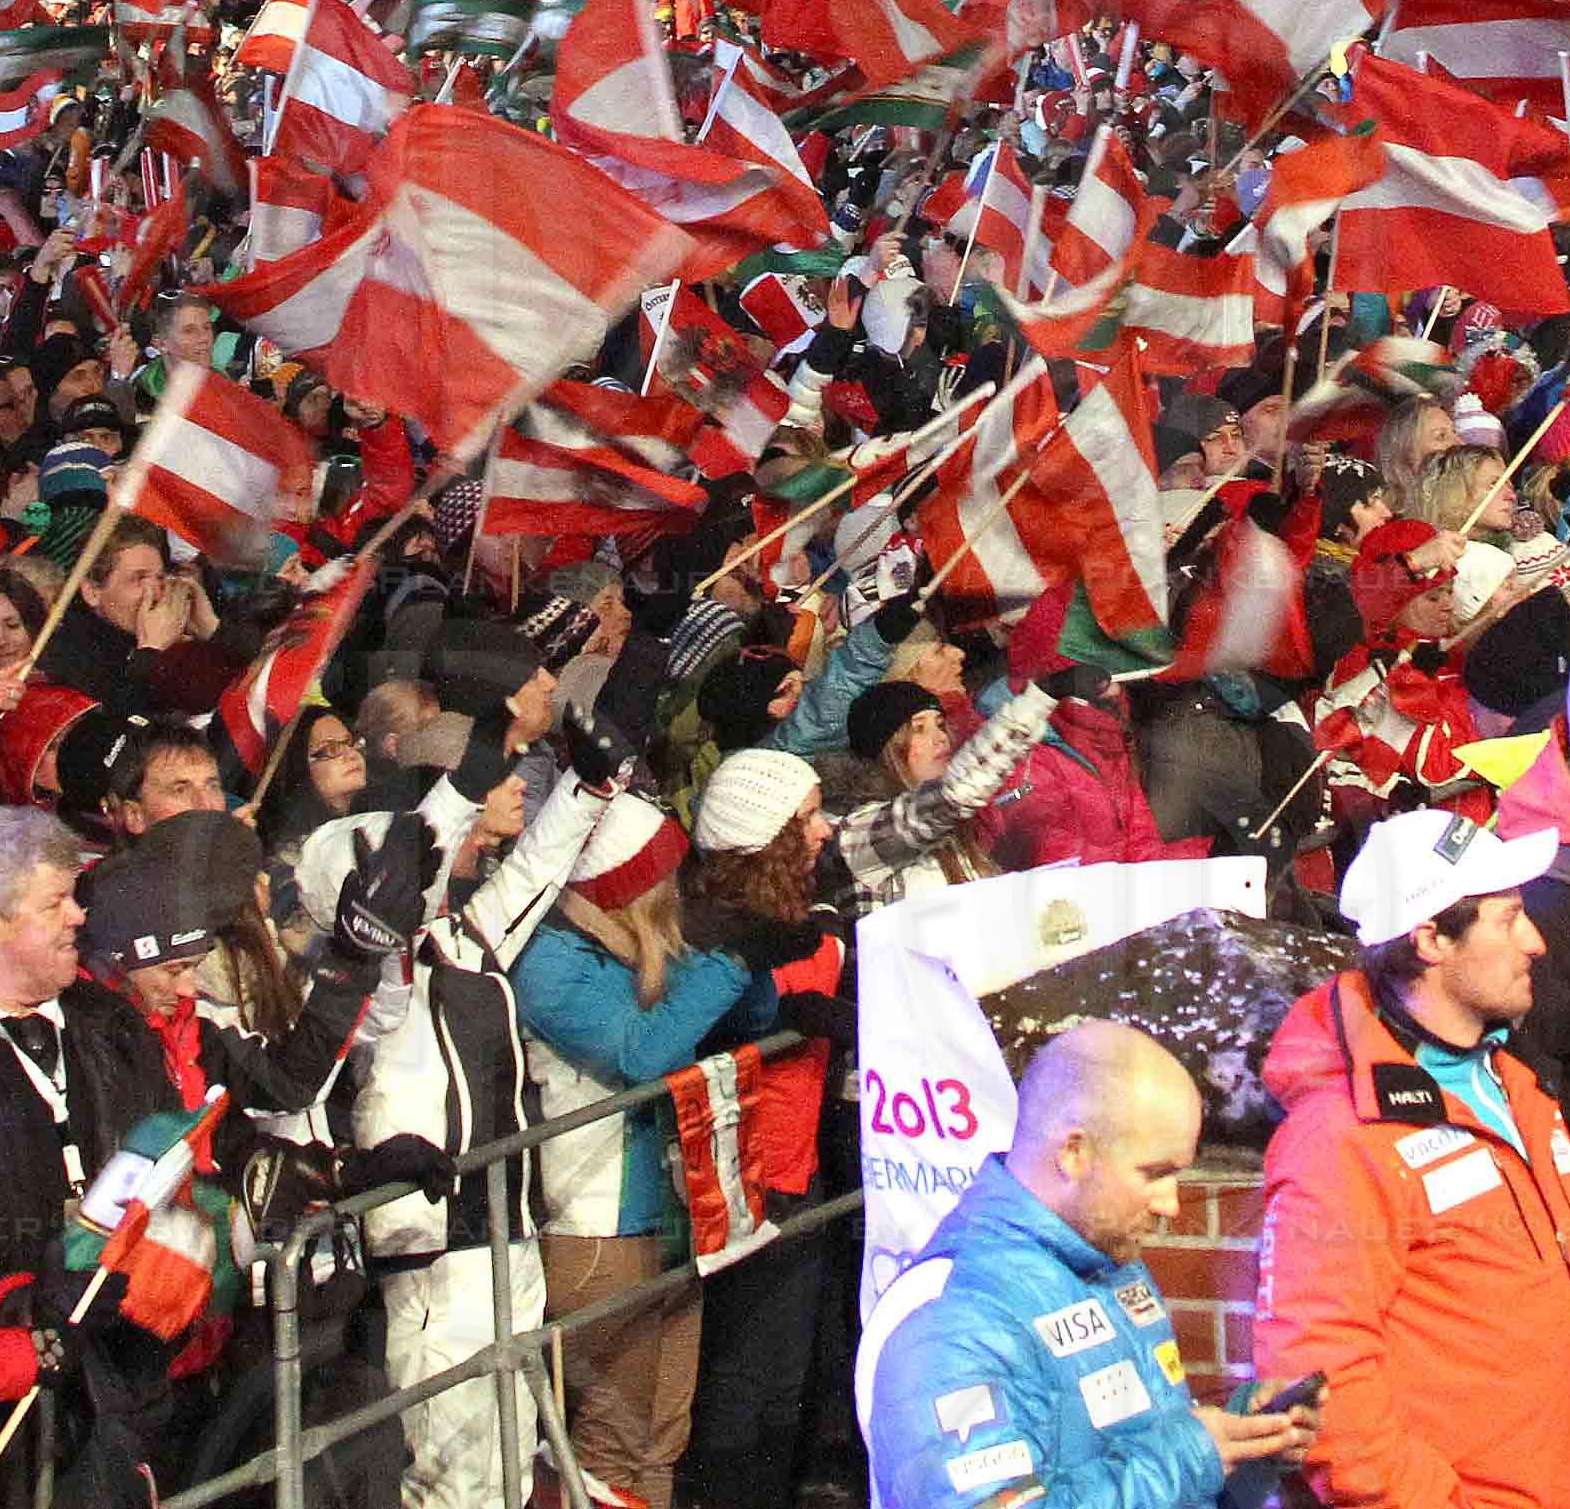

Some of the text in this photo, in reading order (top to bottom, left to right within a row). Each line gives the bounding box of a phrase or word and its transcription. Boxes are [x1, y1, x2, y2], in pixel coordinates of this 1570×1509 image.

[865, 1068, 979, 1141] 2013
[1388, 1090, 1433, 1106] HALTI
[1045, 1307, 1107, 1348] VISA
